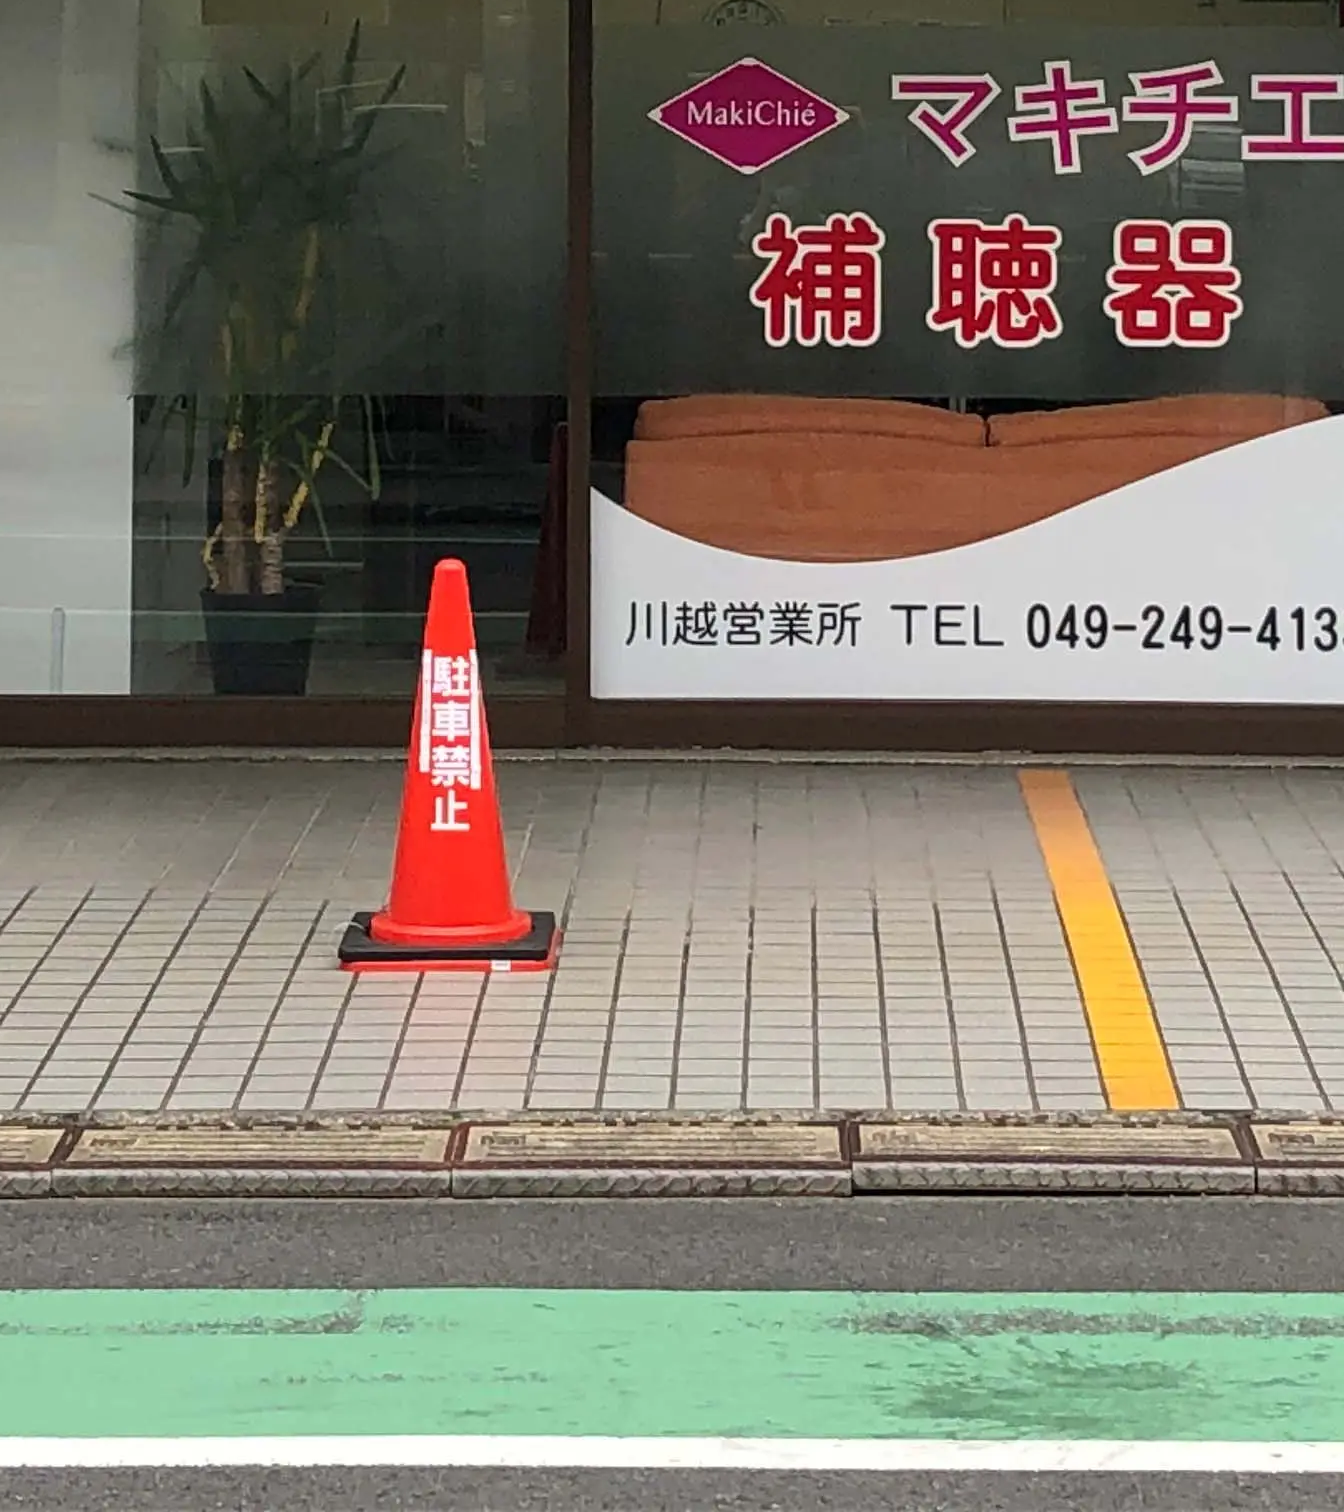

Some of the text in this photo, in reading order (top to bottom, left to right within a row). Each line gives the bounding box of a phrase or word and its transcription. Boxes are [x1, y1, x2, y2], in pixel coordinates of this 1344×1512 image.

[687, 100, 816, 126] MakiChié
[750, 211, 1243, 347] 補聴器
[624, 600, 862, 648] 川越営業所
[890, 603, 1004, 648] TEL
[430, 655, 470, 831] 駐車禁止
